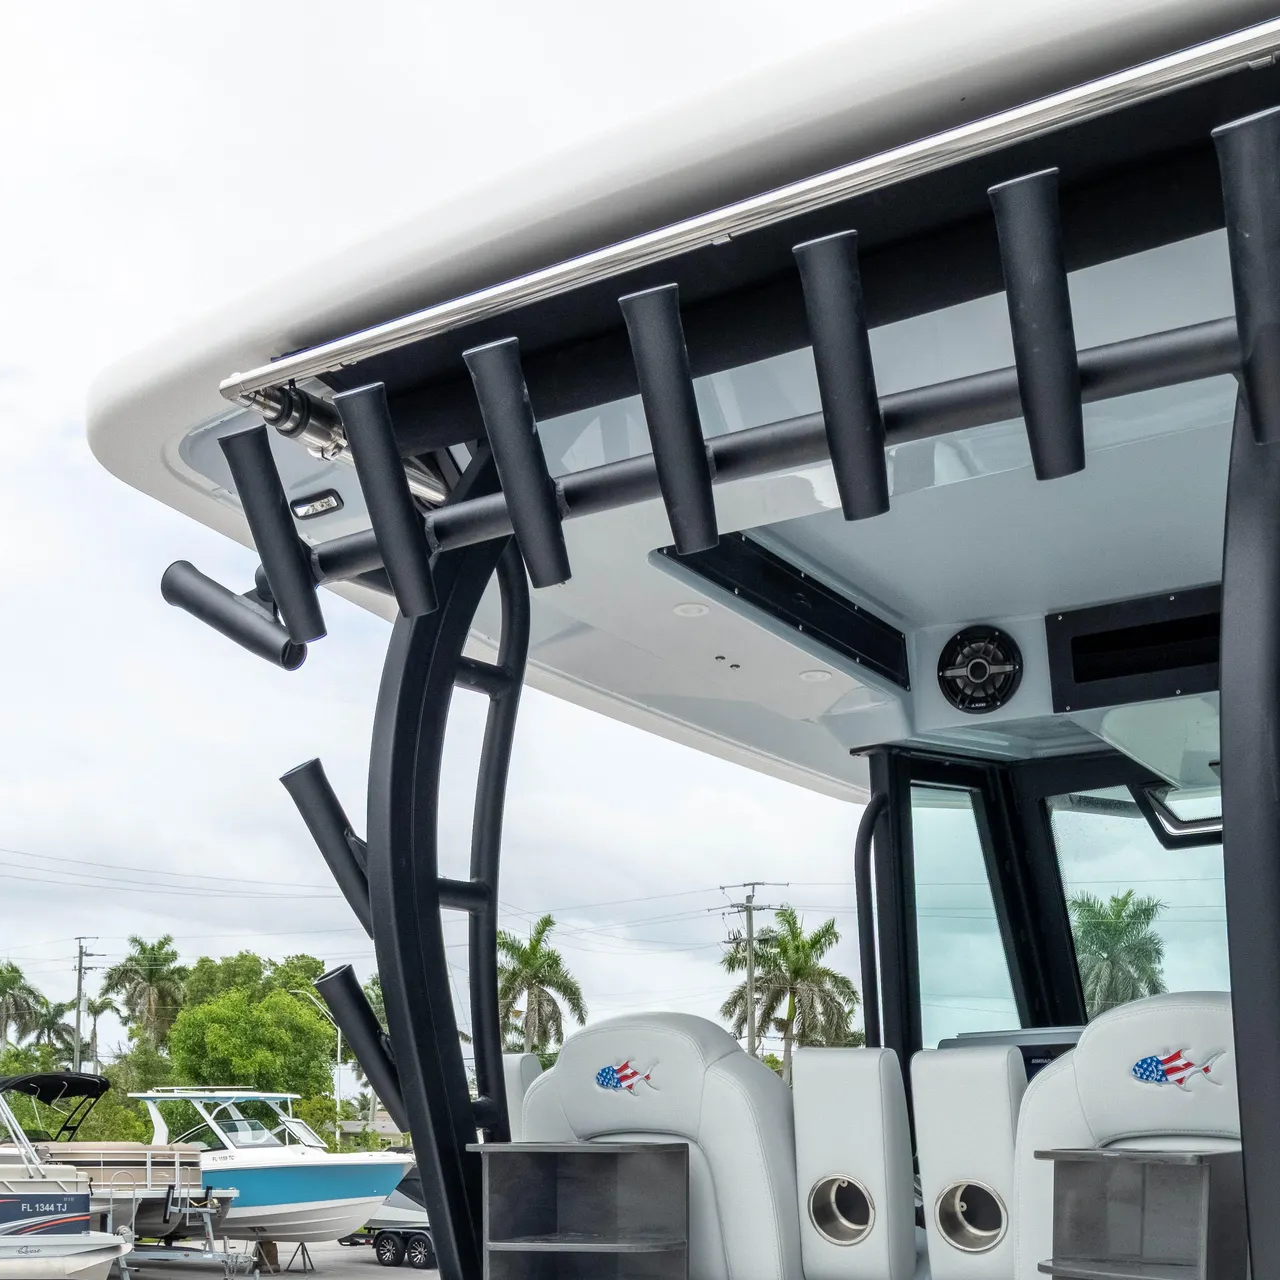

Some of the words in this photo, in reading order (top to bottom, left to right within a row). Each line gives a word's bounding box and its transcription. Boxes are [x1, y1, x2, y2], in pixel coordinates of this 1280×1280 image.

[21, 1203, 33, 1212] FL
[34, 1203, 55, 1212] 1344
[56, 1203, 67, 1212] TJ
